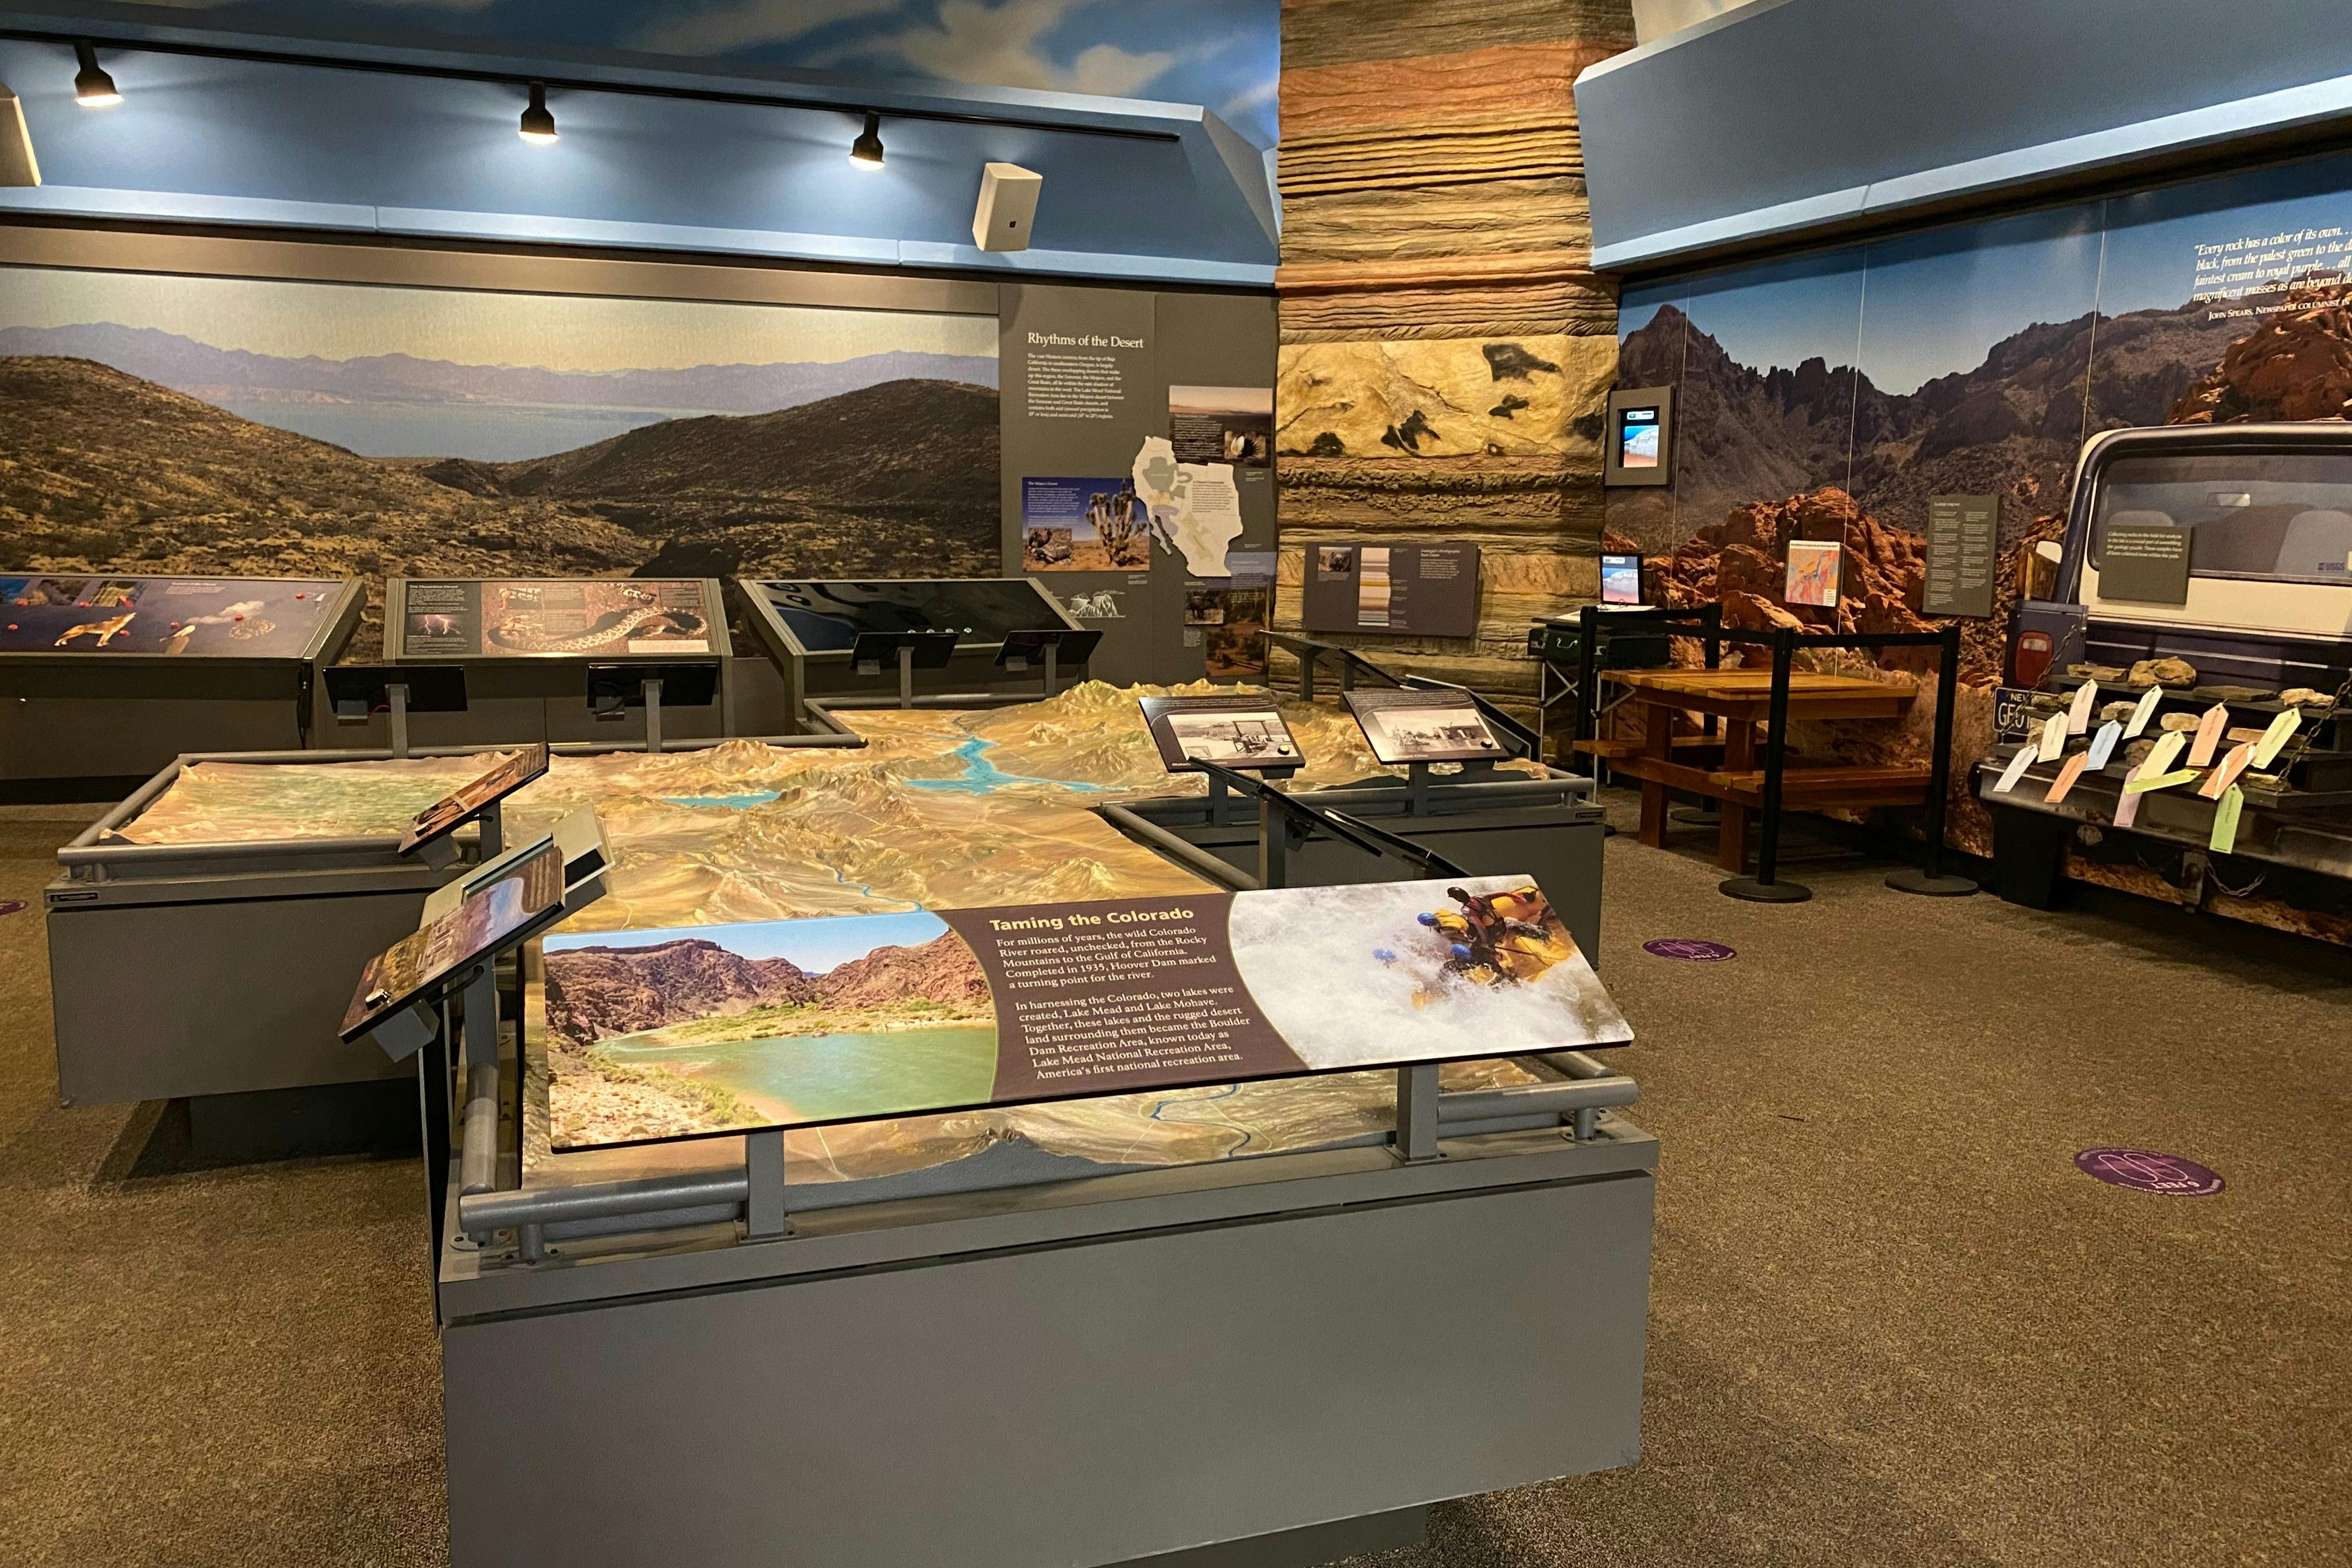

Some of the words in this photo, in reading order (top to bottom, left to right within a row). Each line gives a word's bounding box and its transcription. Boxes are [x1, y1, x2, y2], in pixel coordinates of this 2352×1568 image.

[2225, 239, 2244, 251] rock
[2245, 237, 2260, 249] has
[2262, 237, 2268, 246] a
[2270, 232, 2293, 245] color
[2294, 229, 2305, 245] of
[2305, 229, 2317, 240] its
[2220, 256, 2242, 271] from
[2244, 253, 2259, 264] the
[2259, 249, 2287, 266] palest
[2286, 247, 2314, 262] green
[2315, 244, 2326, 254] to
[2328, 241, 2343, 253] the
[2193, 273, 2225, 289] faintest
[2227, 271, 2253, 282] cream
[2255, 268, 2265, 278] to
[2266, 262, 2291, 279] royal
[2337, 255, 2351, 268] all
[2193, 286, 2244, 303] magnificent
[2245, 284, 2277, 296] masses
[2277, 283, 2288, 292] as
[2290, 281, 2305, 290] are
[2306, 272, 2342, 291] beyond
[1027, 332, 1076, 347] Rhythms
[1078, 335, 1089, 346] of
[1091, 335, 1108, 346] the
[1111, 336, 1144, 348] Desert
[989, 916, 1063, 930] Taming
[1067, 914, 1101, 926] the
[1106, 908, 1194, 923] Colorado
[996, 939, 1014, 947] For
[1017, 936, 1059, 945] millions
[1061, 934, 1072, 942] of
[1074, 934, 1105, 943] years,
[1105, 931, 1123, 939] the
[1124, 929, 1147, 937] wild
[1148, 926, 1196, 936] Colorado
[1030, 945, 1069, 955] roared,
[1069, 940, 1129, 952] unchecked,
[1130, 940, 1156, 948] from
[1174, 936, 1206, 944] Rocky
[1002, 957, 1060, 967] Mountains
[1075, 954, 1093, 962] the
[1094, 951, 1118, 960] Gulf
[1120, 950, 1132, 958] of
[1133, 947, 1188, 957] California.
[1005, 965, 1065, 978] Completed
[1080, 963, 1109, 972] 1935,
[1110, 961, 1149, 970] Hoover
[1178, 954, 1216, 965] marked
[1017, 978, 1059, 988] turning
[1059, 976, 1088, 986] point
[1107, 972, 1125, 981] the
[1126, 971, 1154, 979] river.
[1015, 1002, 1027, 1010] In
[1028, 998, 1087, 1009] harnessing
[1087, 996, 1105, 1004] the
[1107, 991, 1159, 1002] Colorado,
[1181, 988, 1208, 996] lakes
[1019, 1010, 1062, 1021] created,
[1062, 1008, 1089, 1017] Lake
[1091, 1005, 1122, 1015] Mead
[1124, 1003, 1144, 1012] and
[1145, 1001, 1171, 1010] Lake
[1172, 999, 1217, 1008] Mohave.
[1020, 1021, 1073, 1033] Together,
[1073, 1019, 1102, 1028] these
[1103, 1016, 1130, 1026] lakes
[1132, 1013, 1152, 1023] and
[1153, 1012, 1171, 1021] the
[1172, 1009, 1208, 1020] rugged
[1210, 1007, 1242, 1016] desert
[1024, 1034, 1049, 1044] land
[1051, 1028, 1119, 1042] surrounding
[1119, 1027, 1147, 1035] them
[1147, 1024, 1189, 1032] became
[1190, 1020, 1208, 1029] the
[1208, 1017, 1250, 1027] Boulder
[1028, 1046, 1056, 1056] Dam
[1056, 1041, 1117, 1053] Recreation
[1119, 1038, 1147, 1048] Area,
[1147, 1035, 1185, 1044] known
[1186, 1031, 1215, 1041] today
[1032, 1057, 1059, 1068] Lake
[1061, 1053, 1094, 1065] Mead
[1095, 1049, 1142, 1061] National
[1143, 1045, 1201, 1056] Recreation
[1203, 1043, 1231, 1051] Area,
[1036, 1066, 1091, 1079] America's
[1093, 1065, 1115, 1073] first
[1116, 1059, 1160, 1071] national
[1161, 1055, 1216, 1067] recreation
